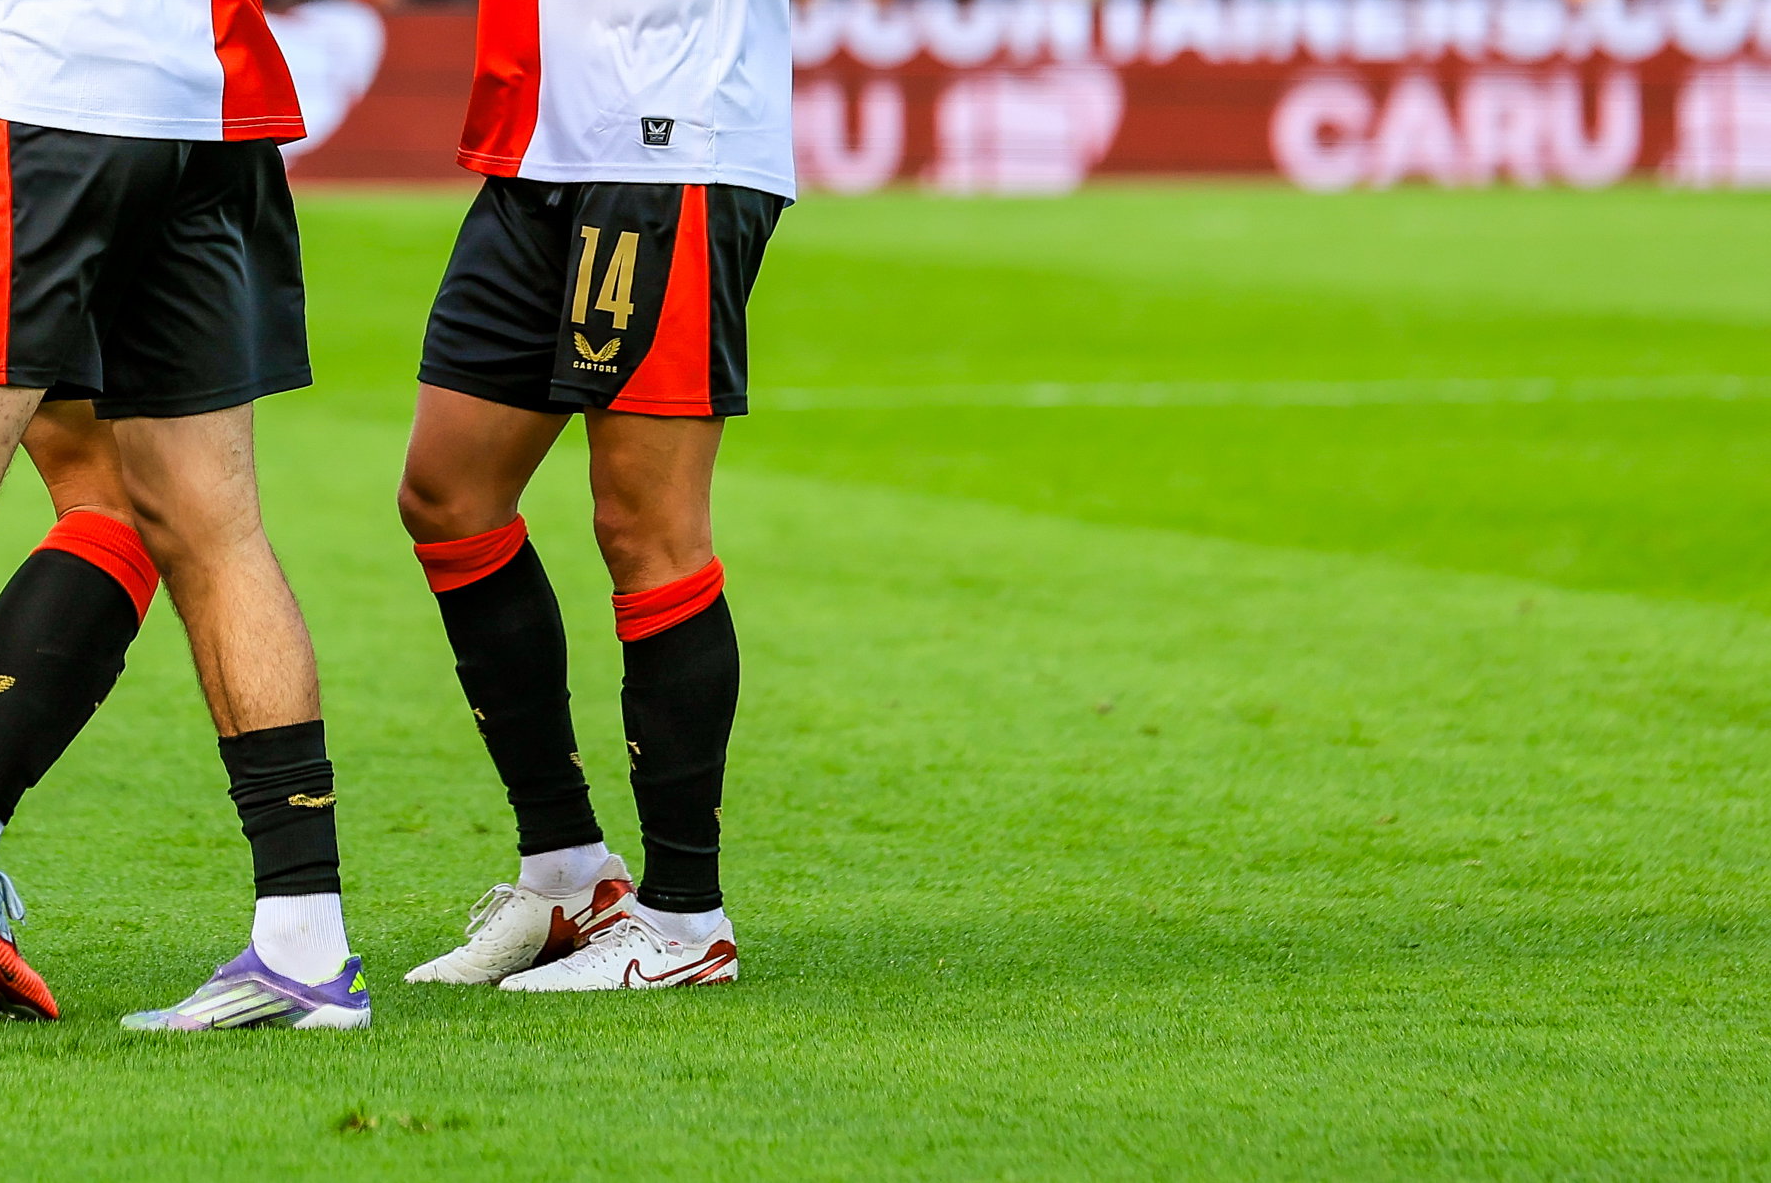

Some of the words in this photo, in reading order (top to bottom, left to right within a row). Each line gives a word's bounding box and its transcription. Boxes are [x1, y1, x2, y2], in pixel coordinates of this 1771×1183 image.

[1270, 66, 1643, 191] CARU
[571, 225, 640, 331] 14
[573, 360, 618, 374] CASTORE
